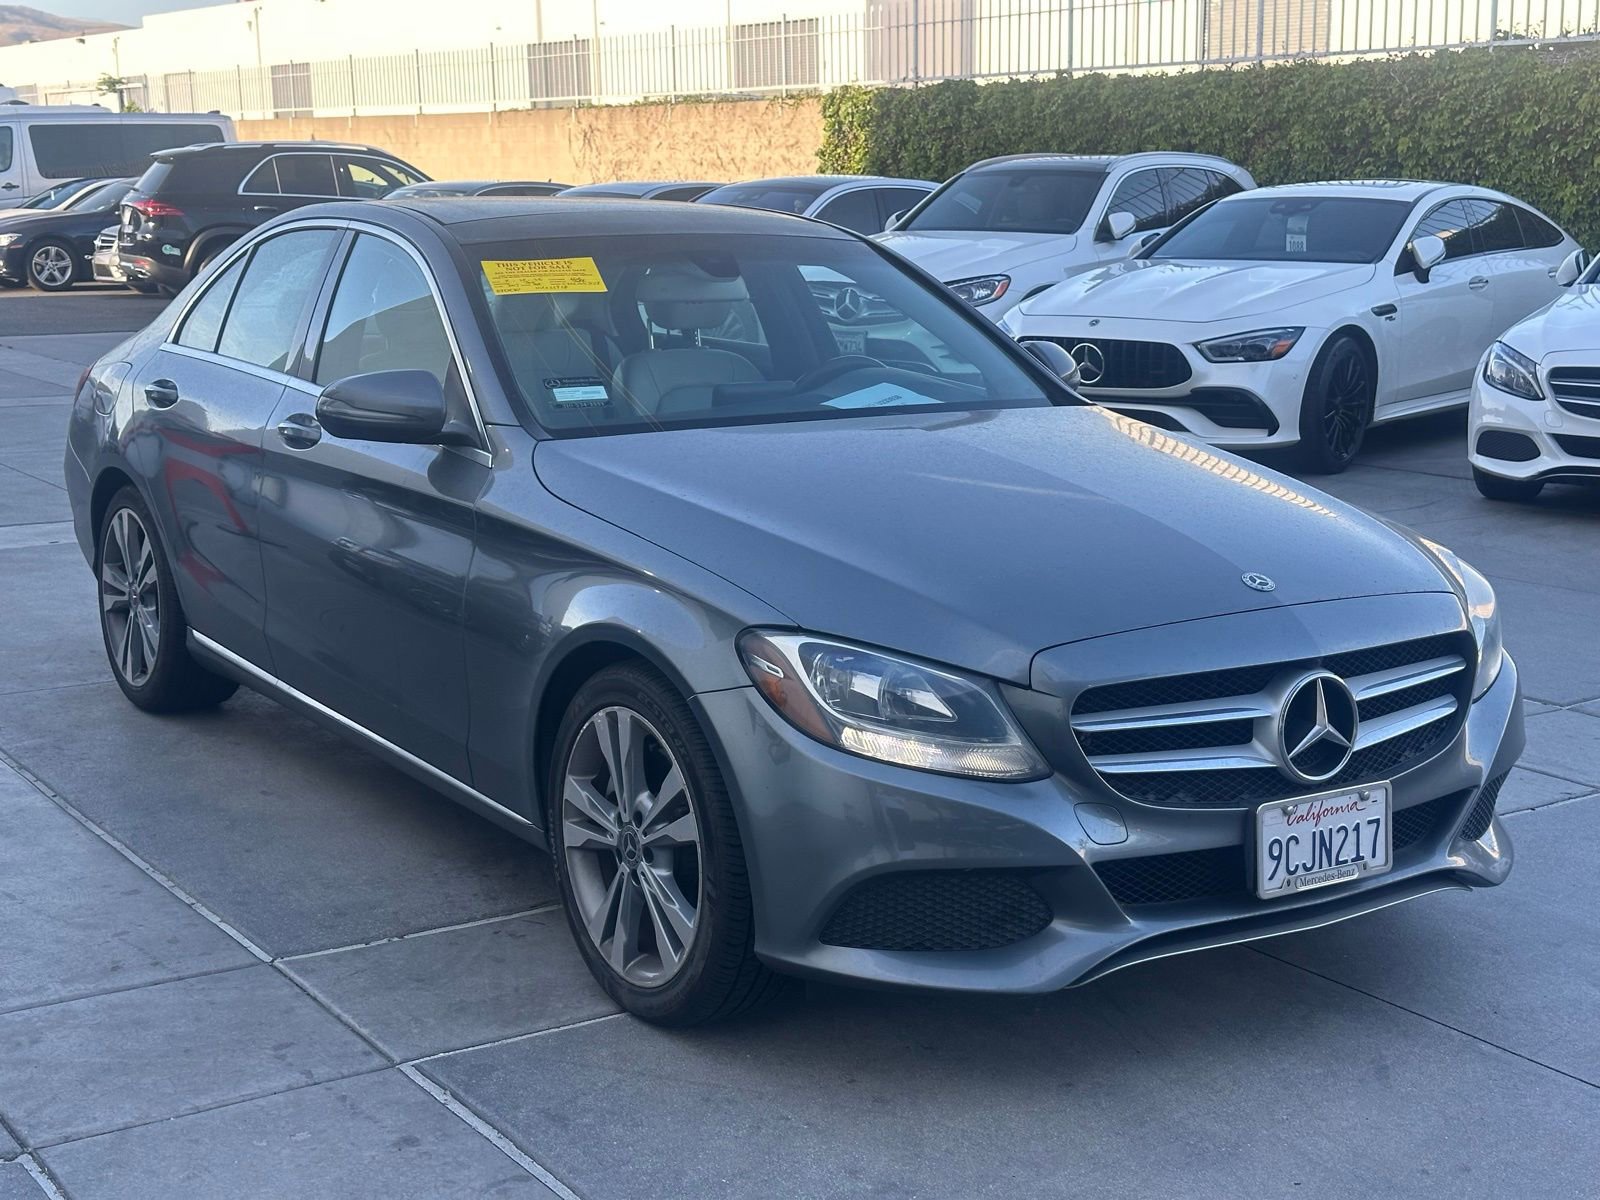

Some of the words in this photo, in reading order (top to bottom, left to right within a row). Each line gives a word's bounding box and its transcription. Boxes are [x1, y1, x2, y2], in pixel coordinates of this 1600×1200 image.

[1286, 797, 1366, 827] California
[1268, 817, 1381, 881] 9CJN217
[1299, 868, 1356, 888] Mercedes-Benz
